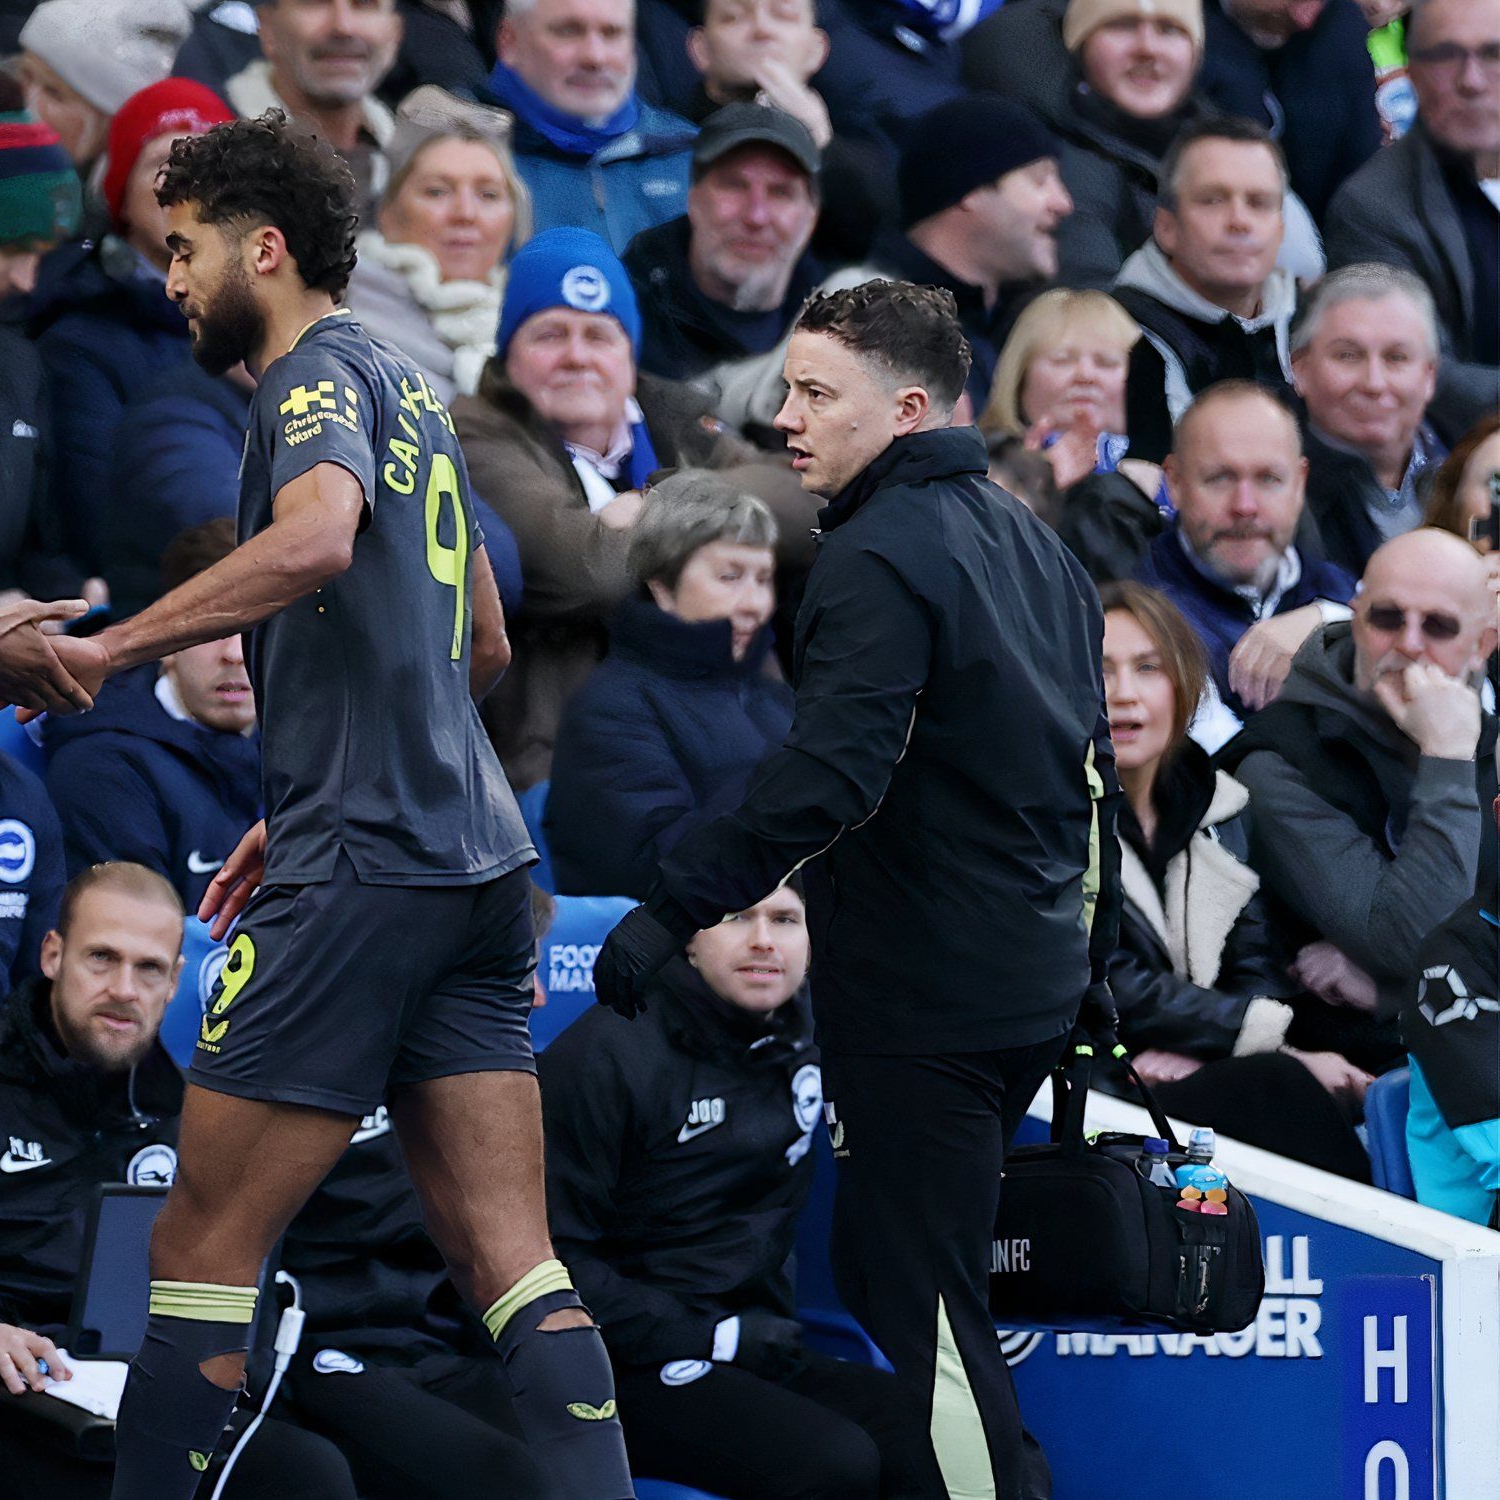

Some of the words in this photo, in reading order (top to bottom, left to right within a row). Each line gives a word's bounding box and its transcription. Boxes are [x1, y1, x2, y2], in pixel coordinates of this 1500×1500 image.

[425, 453, 467, 661] 9
[212, 933, 256, 1015] 9
[549, 944, 603, 968] FOO
[549, 967, 596, 992] MAN
[1012, 1238, 1031, 1272] FC
[1265, 1235, 1324, 1295] LL
